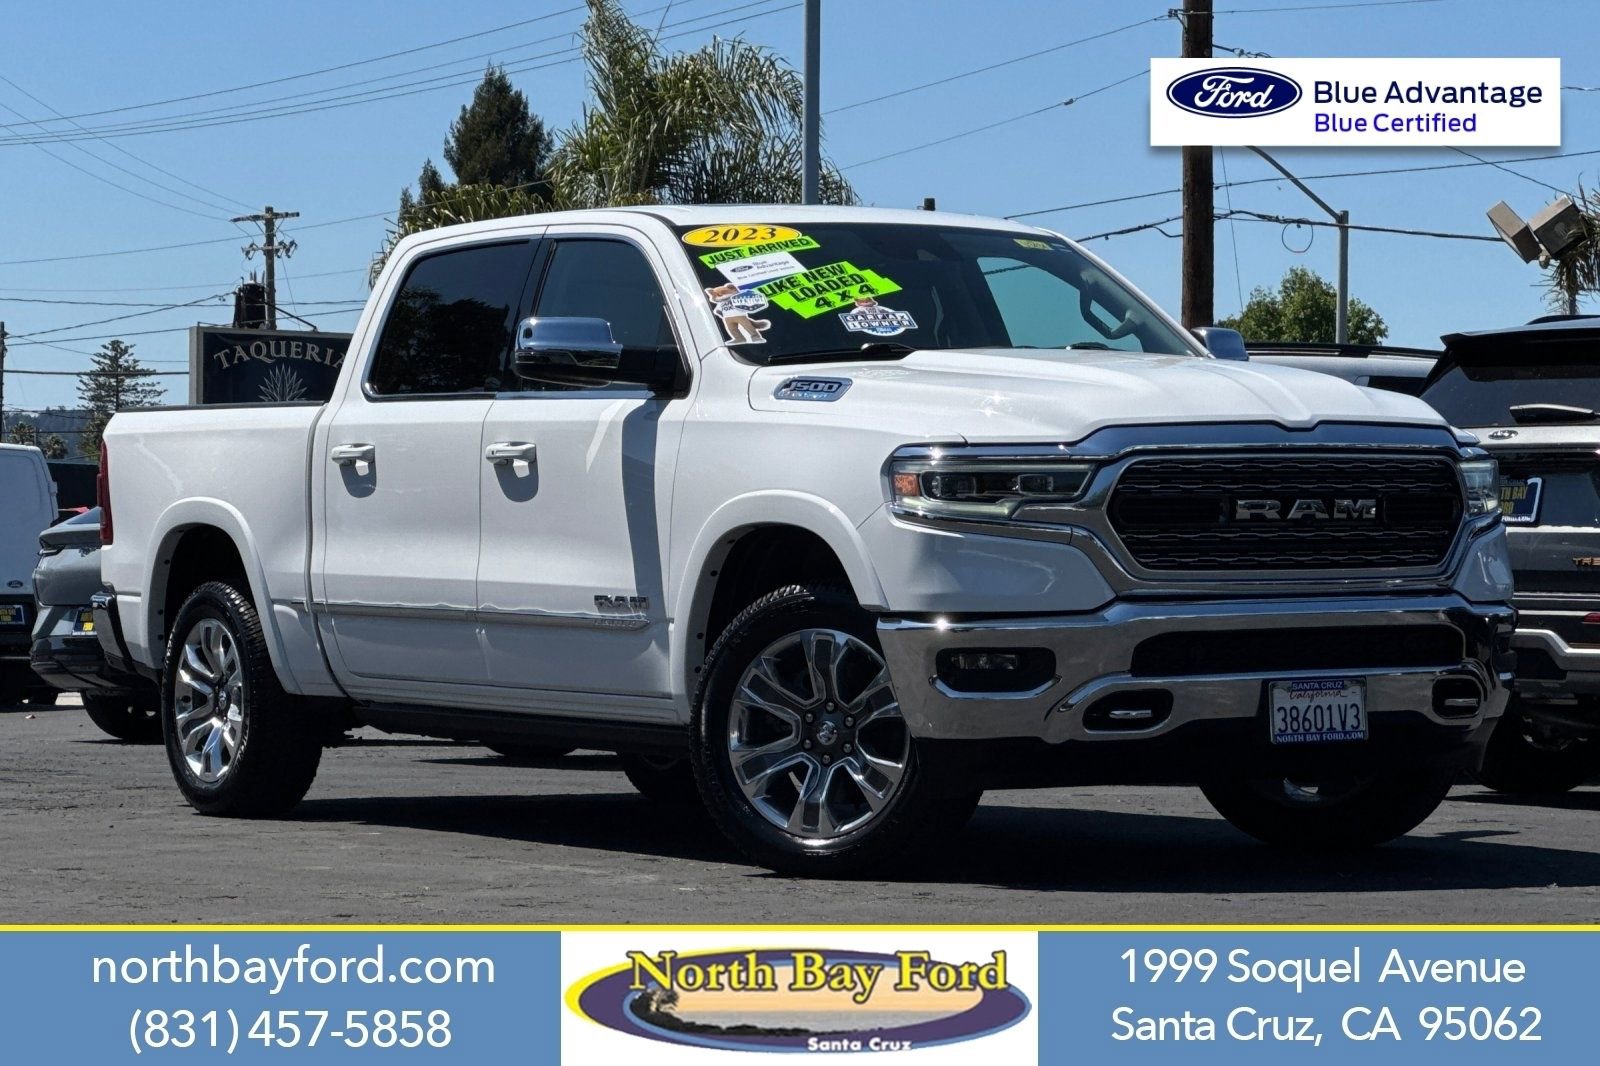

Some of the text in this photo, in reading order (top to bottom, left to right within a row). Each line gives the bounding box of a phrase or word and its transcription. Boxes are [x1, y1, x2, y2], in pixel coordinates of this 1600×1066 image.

[703, 227, 778, 244] 2023
[707, 237, 812, 265] JUST ARRIVED
[758, 276, 800, 299] LIKE
[805, 264, 846, 284] NEW
[790, 272, 866, 302] LOADED
[814, 297, 836, 310] 4
[856, 283, 878, 295] 4
[213, 340, 345, 370] TAQUERIA
[788, 381, 840, 392] 1500
[1236, 499, 1377, 520] RAM
[594, 595, 649, 611] RAM
[1289, 690, 1348, 702] California
[1292, 681, 1343, 690] SANTA CRUZ
[1277, 703, 1361, 733] 38601V3
[1277, 731, 1364, 743] NORTH BAY FORD.COM
